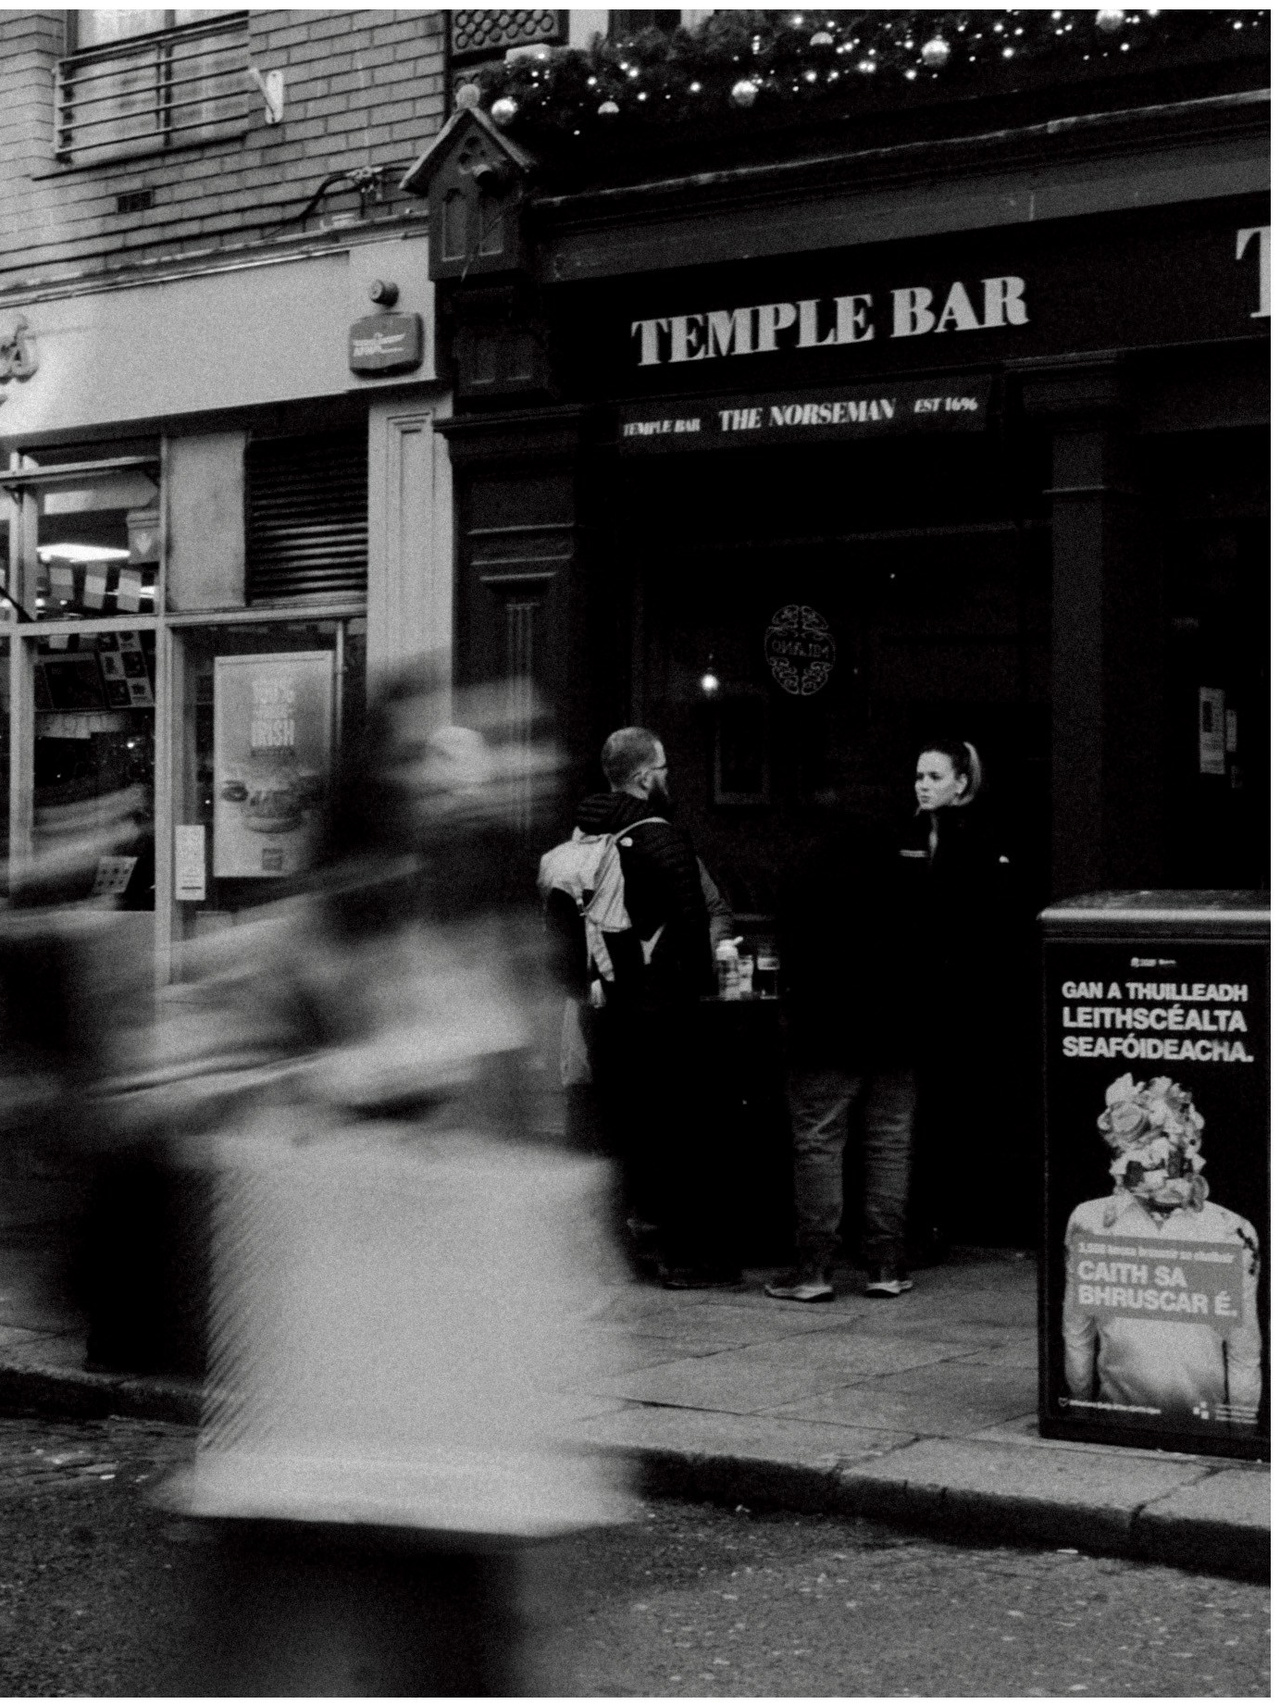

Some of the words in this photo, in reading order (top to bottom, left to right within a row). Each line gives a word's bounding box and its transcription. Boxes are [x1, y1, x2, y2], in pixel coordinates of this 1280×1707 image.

[630, 293, 875, 367] TEMPLE
[890, 275, 1031, 338] BAR
[623, 419, 672, 437] TEMPLE
[674, 417, 701, 433] BAR
[719, 407, 763, 432] THE
[769, 399, 897, 427] NORSEMAN
[914, 399, 943, 413] EST
[944, 396, 979, 412] 1696
[1061, 981, 1104, 999] GAN
[1107, 981, 1122, 999] A
[1125, 982, 1249, 1002] THUILLEADH
[1062, 1003, 1248, 1032] LEITHSCÉALTA
[1062, 1032, 1255, 1063] SEAFÓIDEACHA.
[1077, 1260, 1149, 1285] CAITH
[1154, 1265, 1188, 1288] SA
[1078, 1284, 1209, 1314] BHRUSCAR
